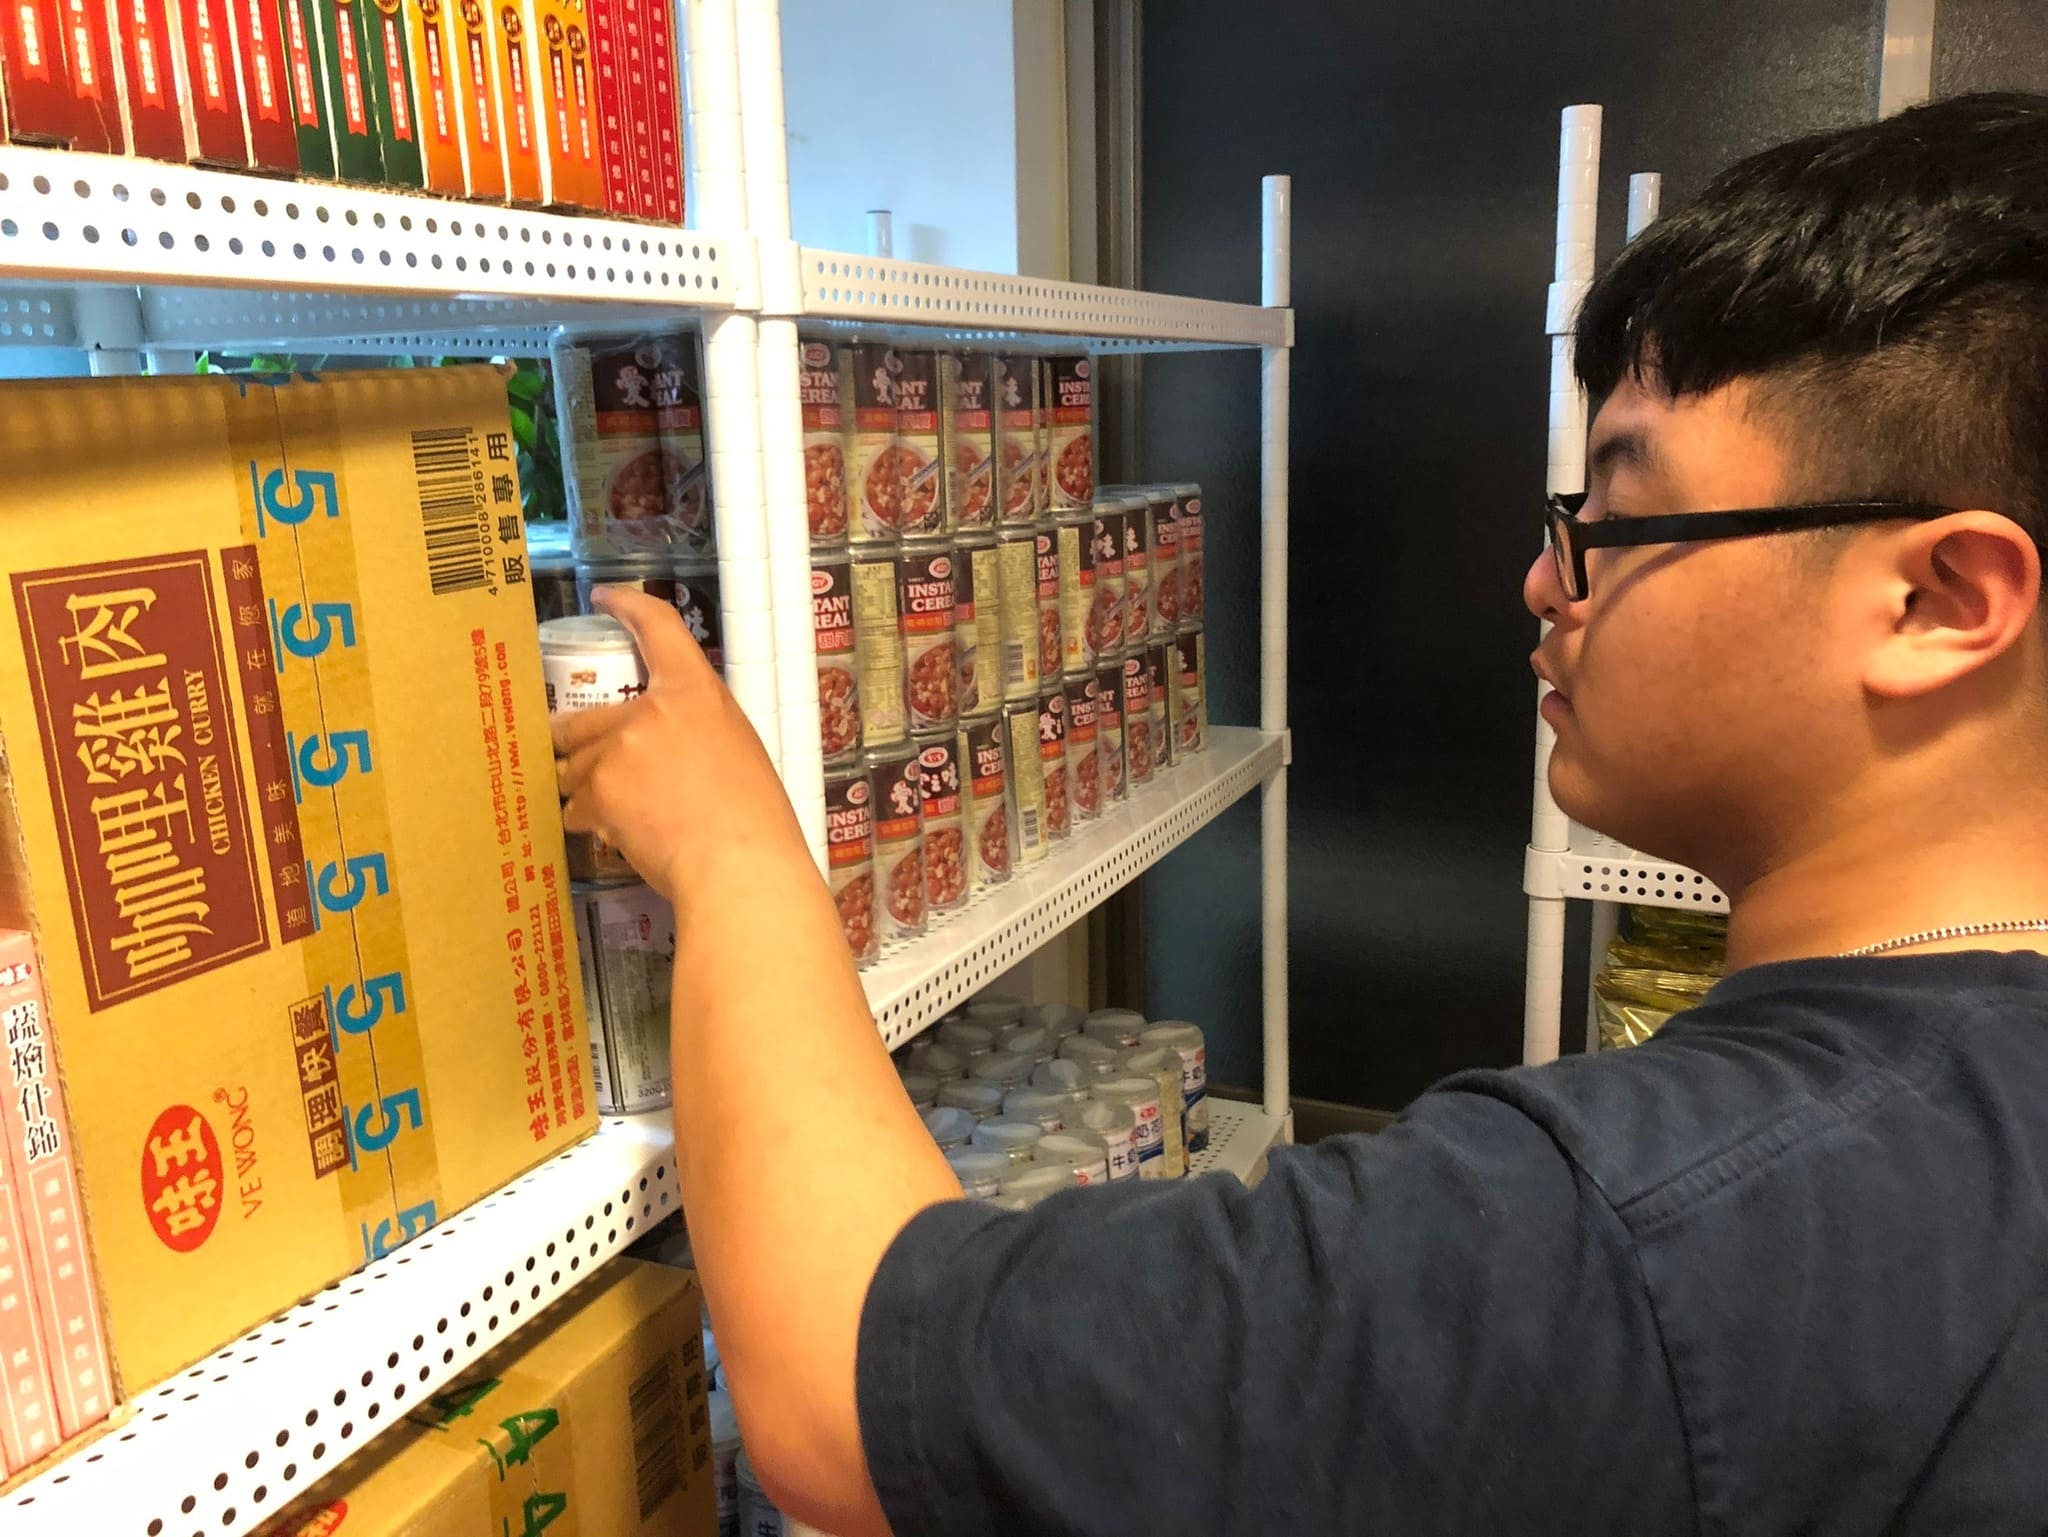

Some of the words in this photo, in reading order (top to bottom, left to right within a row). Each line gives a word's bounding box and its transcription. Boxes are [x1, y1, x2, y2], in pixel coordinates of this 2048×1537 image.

[262, 468, 340, 525] 5
[486, 432, 526, 585] 販售專用
[281, 602, 356, 658] 5
[183, 669, 214, 746] CURRY
[58, 585, 215, 978] 咖哩雞肉
[299, 730, 372, 787] 5
[198, 754, 231, 856] CHICKEN
[317, 853, 389, 912] 5
[336, 972, 406, 1034] 5
[506, 927, 550, 1142] 味王股份有限公司
[292, 998, 346, 1171] 調理快餐
[355, 1087, 423, 1152] 5
[227, 1086, 258, 1179] WONG
[149, 1115, 217, 1236] 味王
[240, 1177, 263, 1220] VE
